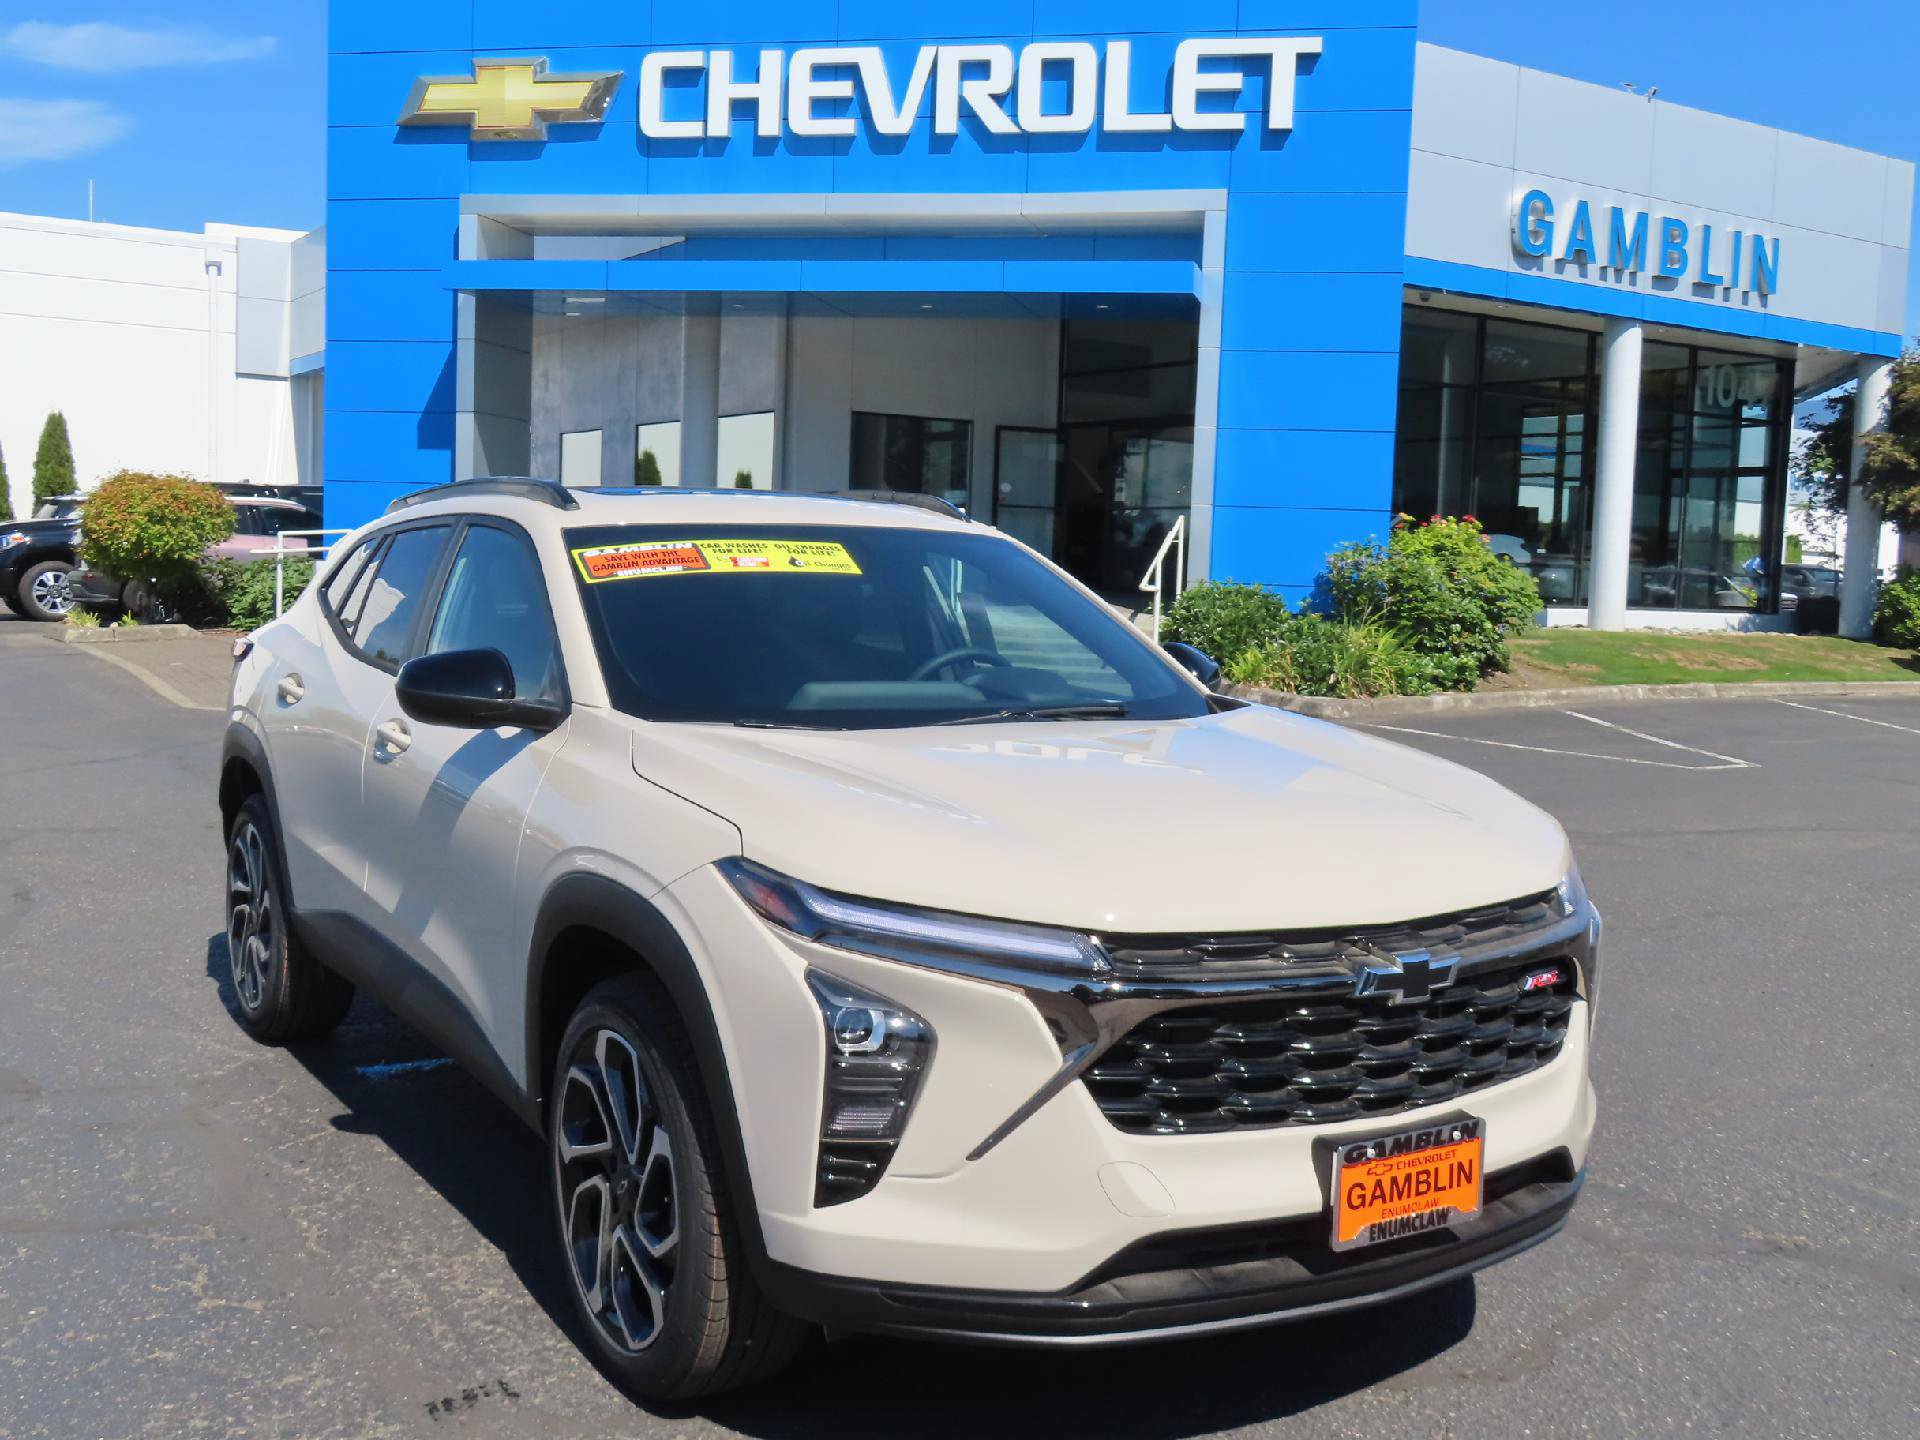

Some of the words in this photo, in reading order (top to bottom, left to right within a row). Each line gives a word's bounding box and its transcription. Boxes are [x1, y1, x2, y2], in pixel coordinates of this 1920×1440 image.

[639, 36, 1323, 139] CHEVROLET
[1511, 189, 1780, 296] GAMBLIN
[604, 555, 629, 563] SAVE
[631, 552, 659, 561] WITH
[661, 550, 681, 558] THE
[795, 544, 841, 552] CHANGES
[593, 560, 640, 572] GAMBLIN
[642, 556, 700, 567] ADVANTAGE
[1396, 1149, 1457, 1170] CHEVROLET
[1346, 1159, 1473, 1211] GAMBLIN
[1381, 1198, 1440, 1220] ENUMCLAW
[1369, 1208, 1450, 1242] ENUMCLAW
